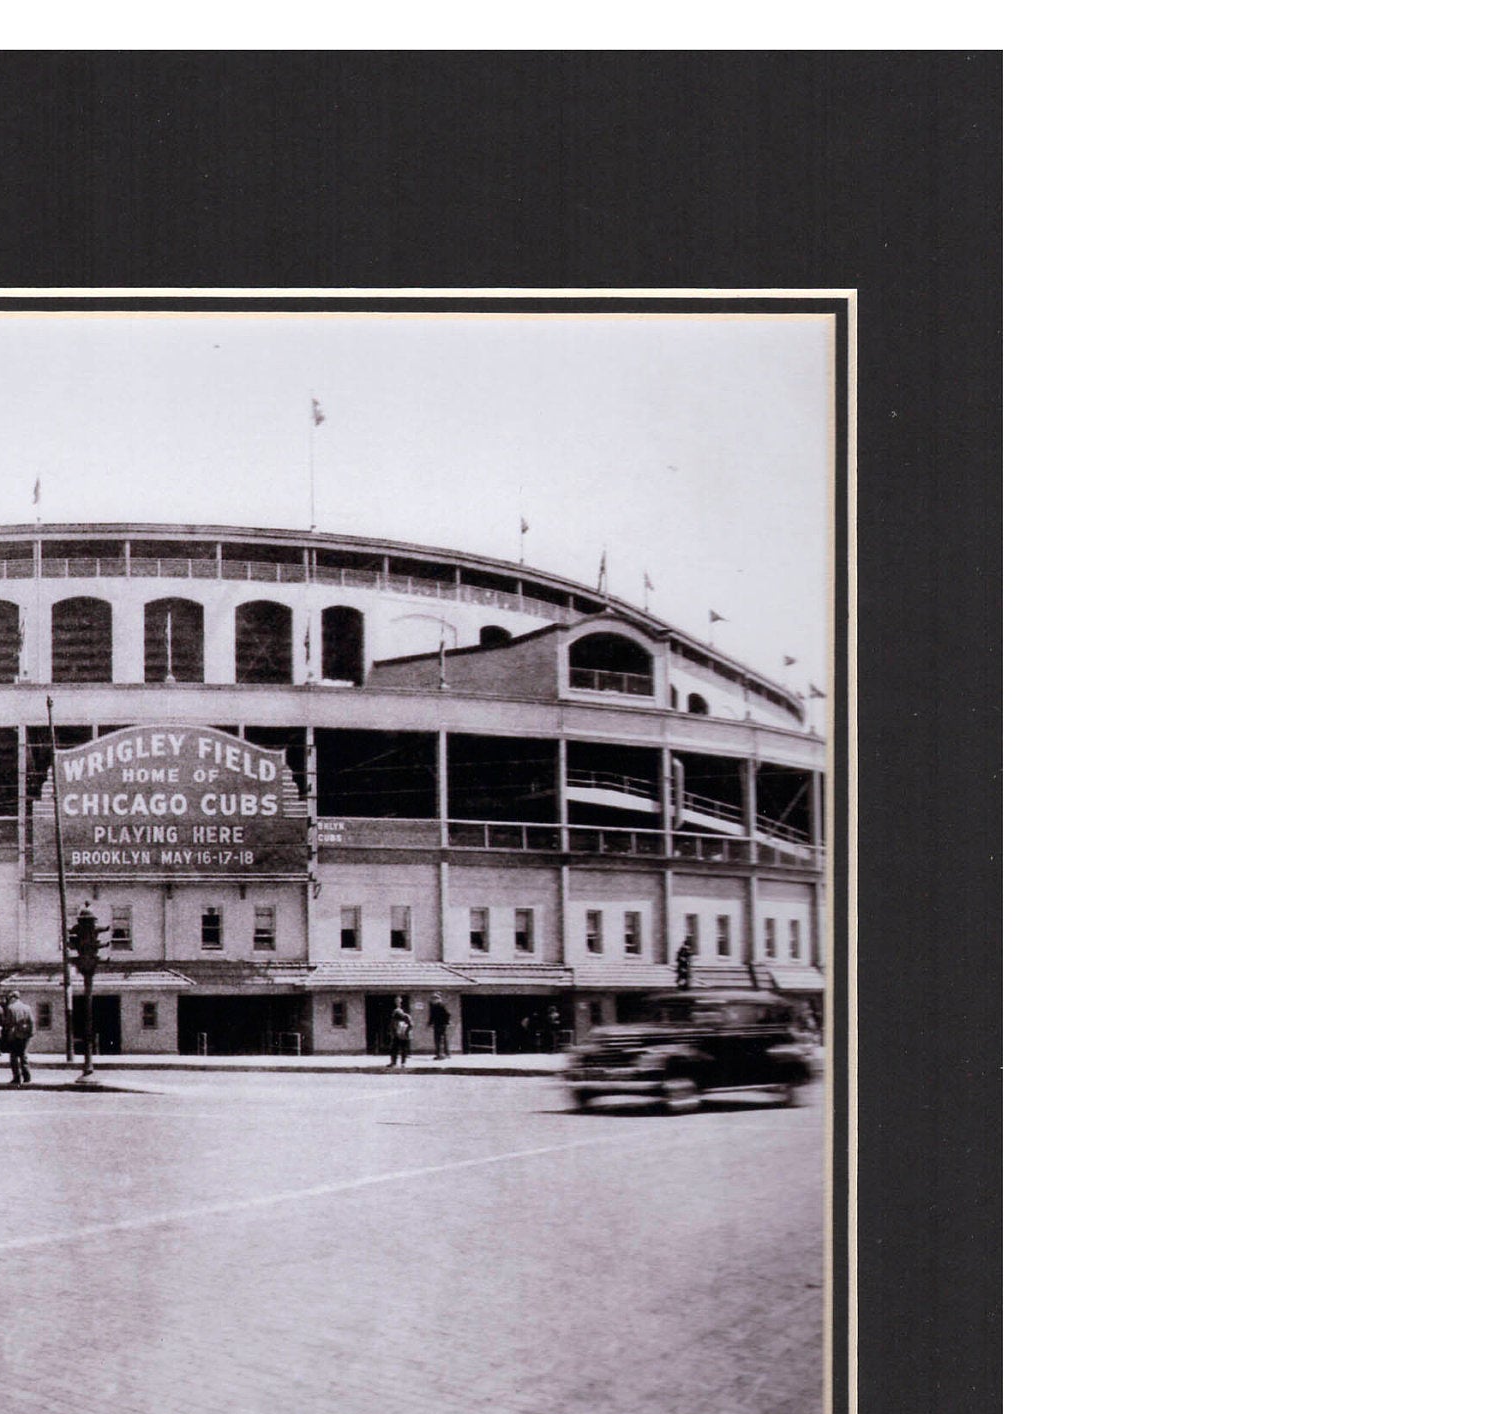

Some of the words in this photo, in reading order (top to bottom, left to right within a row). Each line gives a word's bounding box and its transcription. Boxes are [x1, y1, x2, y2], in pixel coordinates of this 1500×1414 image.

[62, 733, 186, 782] WRIGLEY
[199, 737, 277, 782] FIELD
[122, 768, 179, 783] HOME
[193, 768, 218, 783] OF
[62, 794, 188, 816] CHICAGO
[201, 793, 278, 816] CUBS
[94, 826, 177, 843] PLAYING
[192, 827, 244, 843] HERE
[71, 851, 151, 865] BROOKLYN
[160, 851, 192, 865] MAY
[197, 851, 254, 865] 16-17-18
